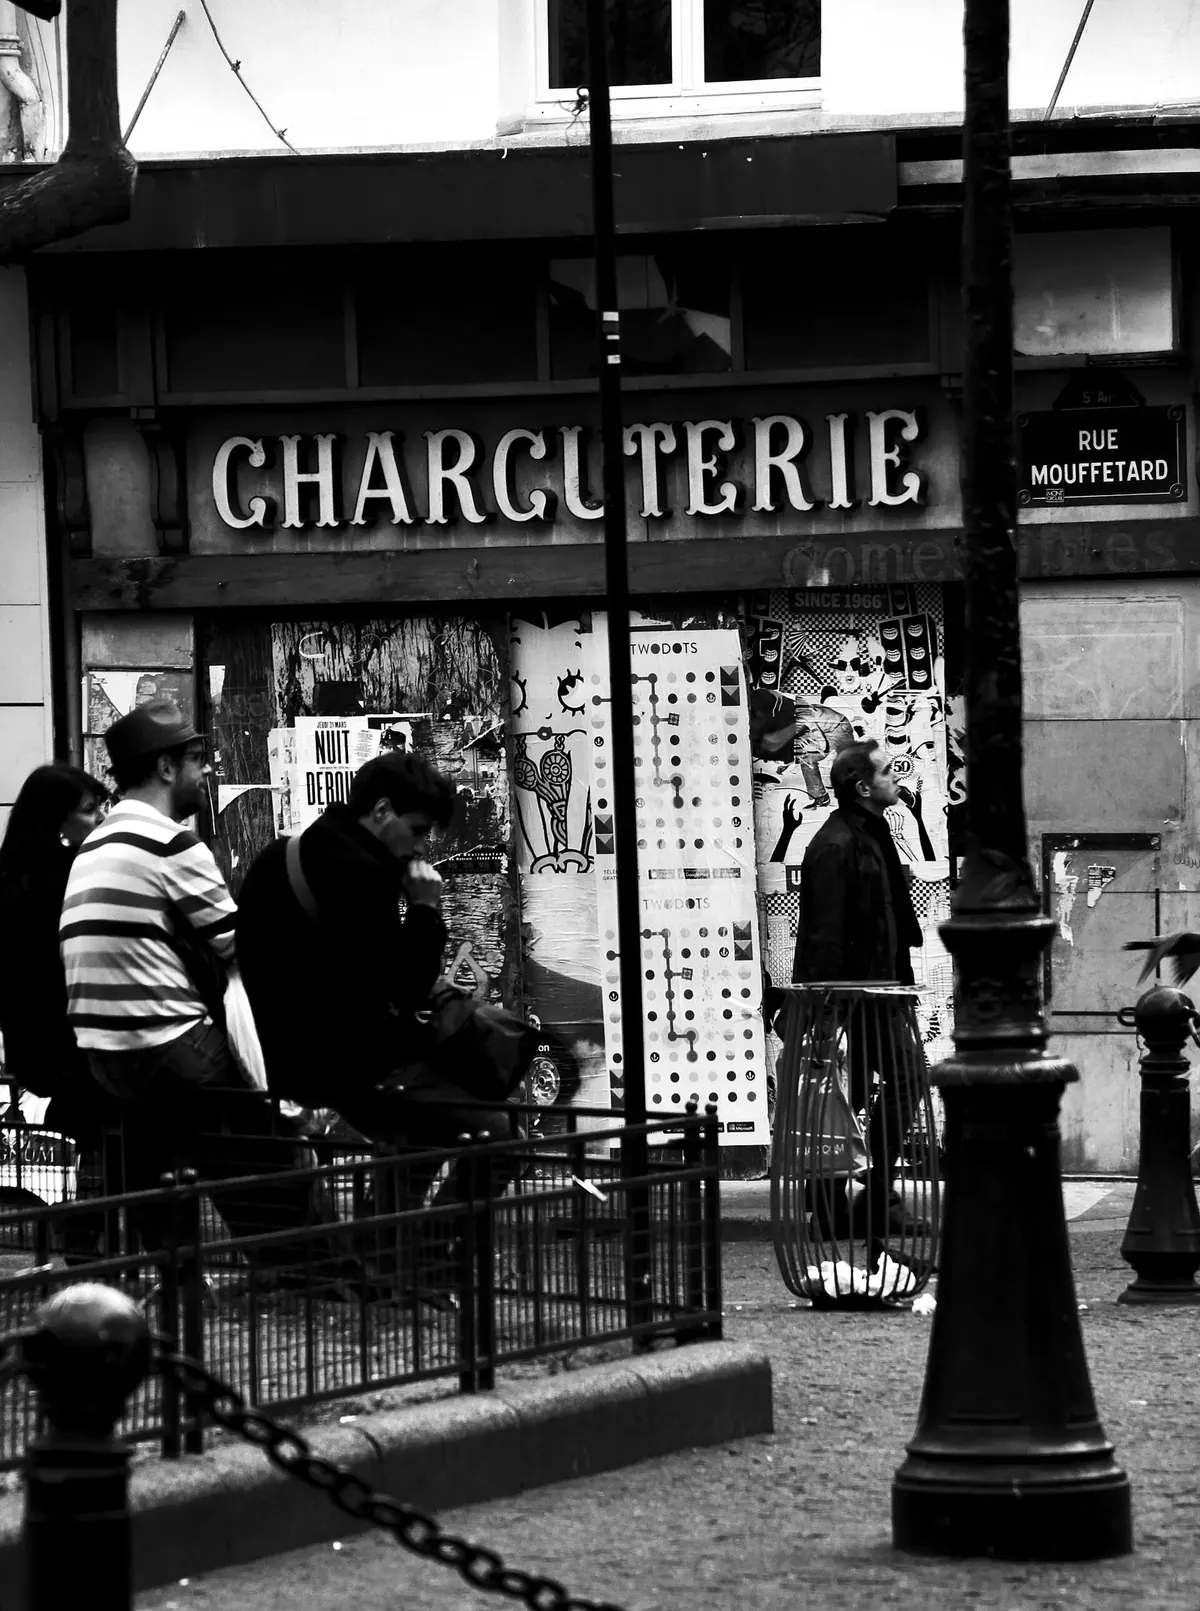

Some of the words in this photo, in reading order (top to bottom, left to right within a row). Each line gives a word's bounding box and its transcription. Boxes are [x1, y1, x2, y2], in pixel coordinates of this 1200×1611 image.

[1078, 429, 1118, 451] RUE
[212, 409, 921, 529] CHARCUTERIE
[1031, 459, 1168, 486] MOUFFETARD
[794, 592, 840, 609] SINCE
[315, 730, 350, 765] NUIT
[893, 760, 911, 773] 50
[306, 770, 358, 806] DEBOU
